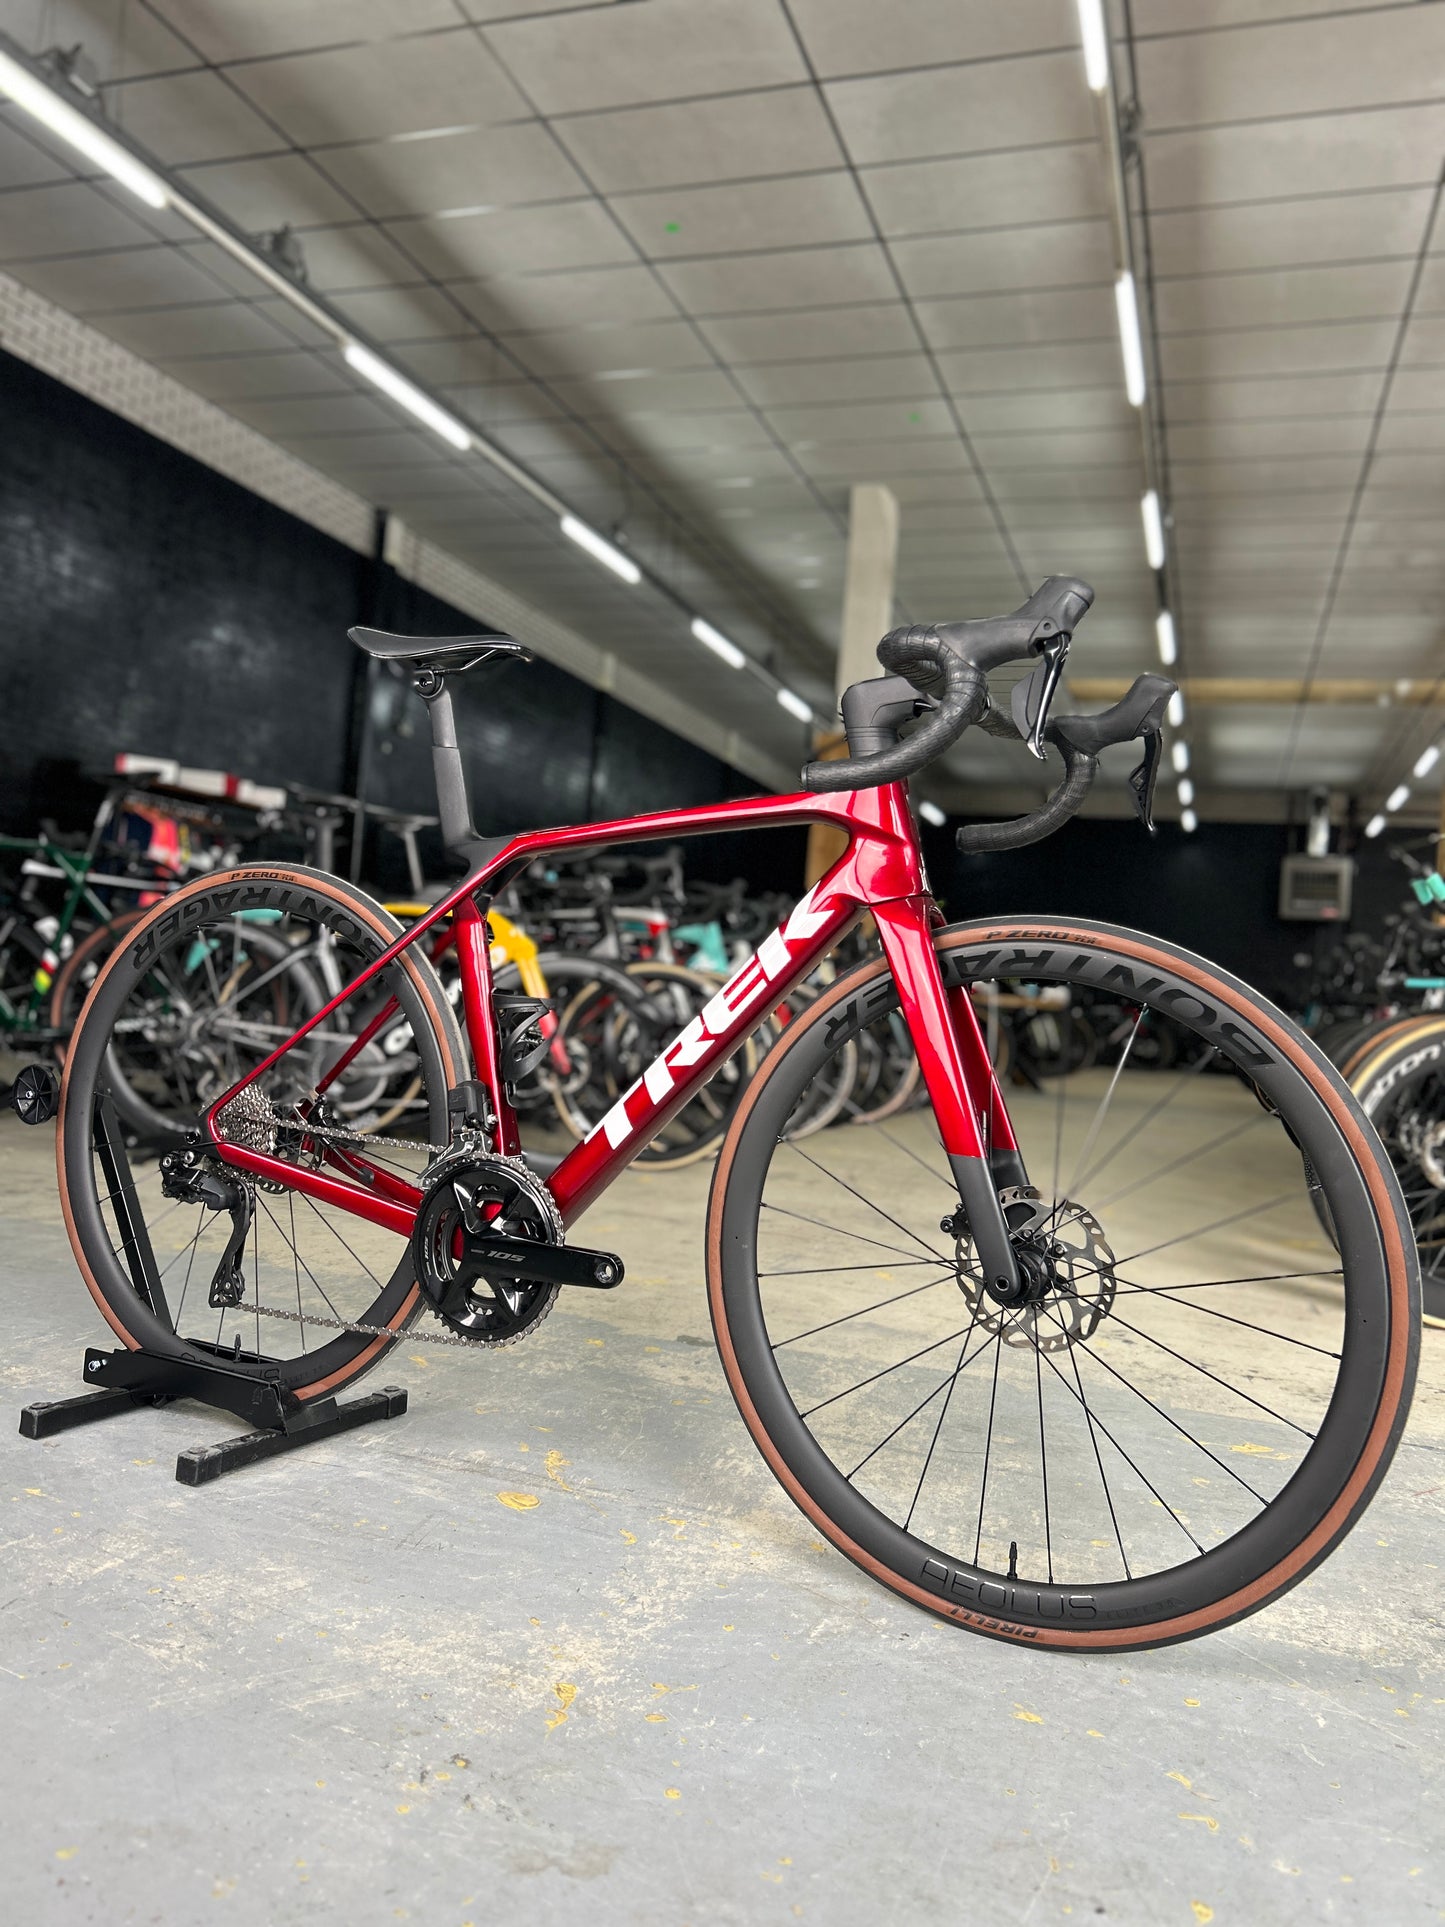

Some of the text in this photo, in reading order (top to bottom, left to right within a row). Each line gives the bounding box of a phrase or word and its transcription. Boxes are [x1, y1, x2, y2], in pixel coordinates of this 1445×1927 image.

[1006, 930, 1070, 939] ZERO
[584, 880, 835, 1150] TREK
[824, 950, 1275, 1066] BONTRAER
[487, 1250, 526, 1262] 105
[919, 1556, 1097, 1619] AEOLUS
[950, 1607, 1039, 1638] PIRELLI
